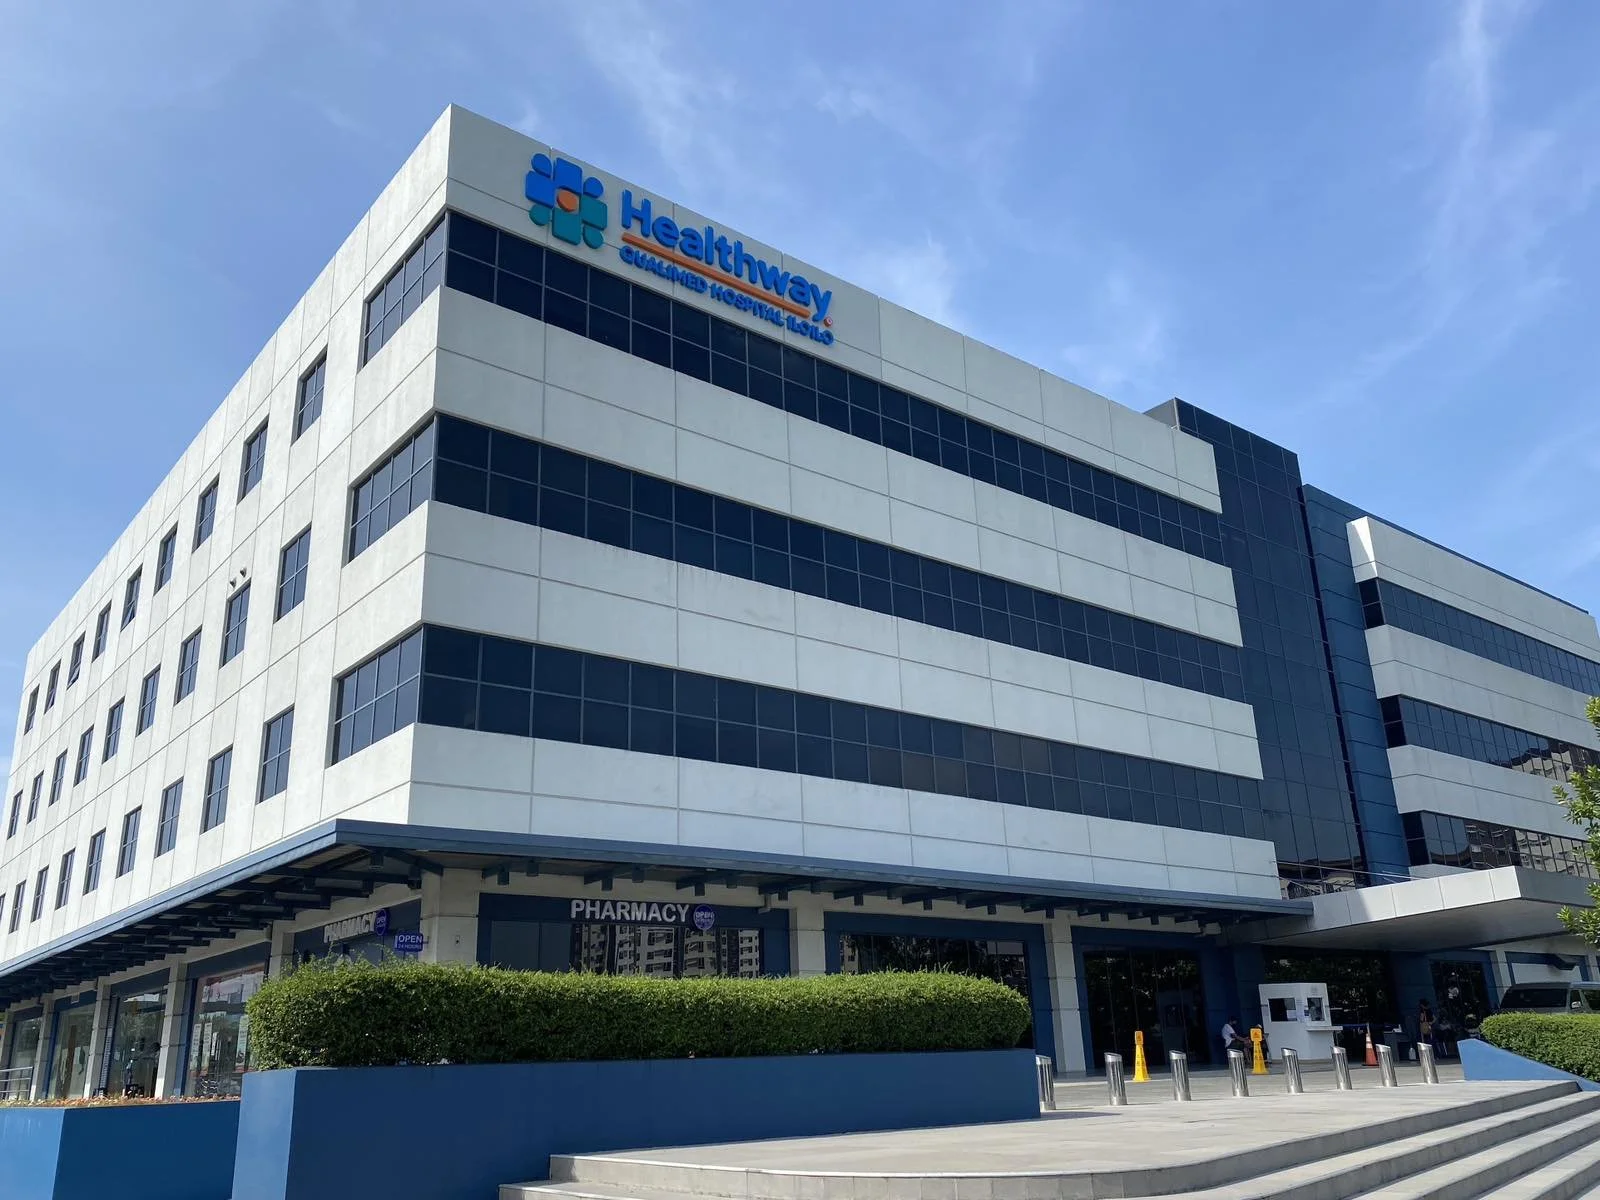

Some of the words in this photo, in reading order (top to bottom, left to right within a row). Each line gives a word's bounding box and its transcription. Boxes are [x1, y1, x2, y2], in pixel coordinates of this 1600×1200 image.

[621, 188, 833, 322] Healthway
[619, 245, 708, 294] QUALIMED
[709, 283, 785, 327] HOSPITAL
[786, 315, 835, 346] ILOILO
[323, 910, 377, 944] PHARMACY
[570, 899, 690, 923] PHARMACY
[398, 934, 423, 944] OPEN
